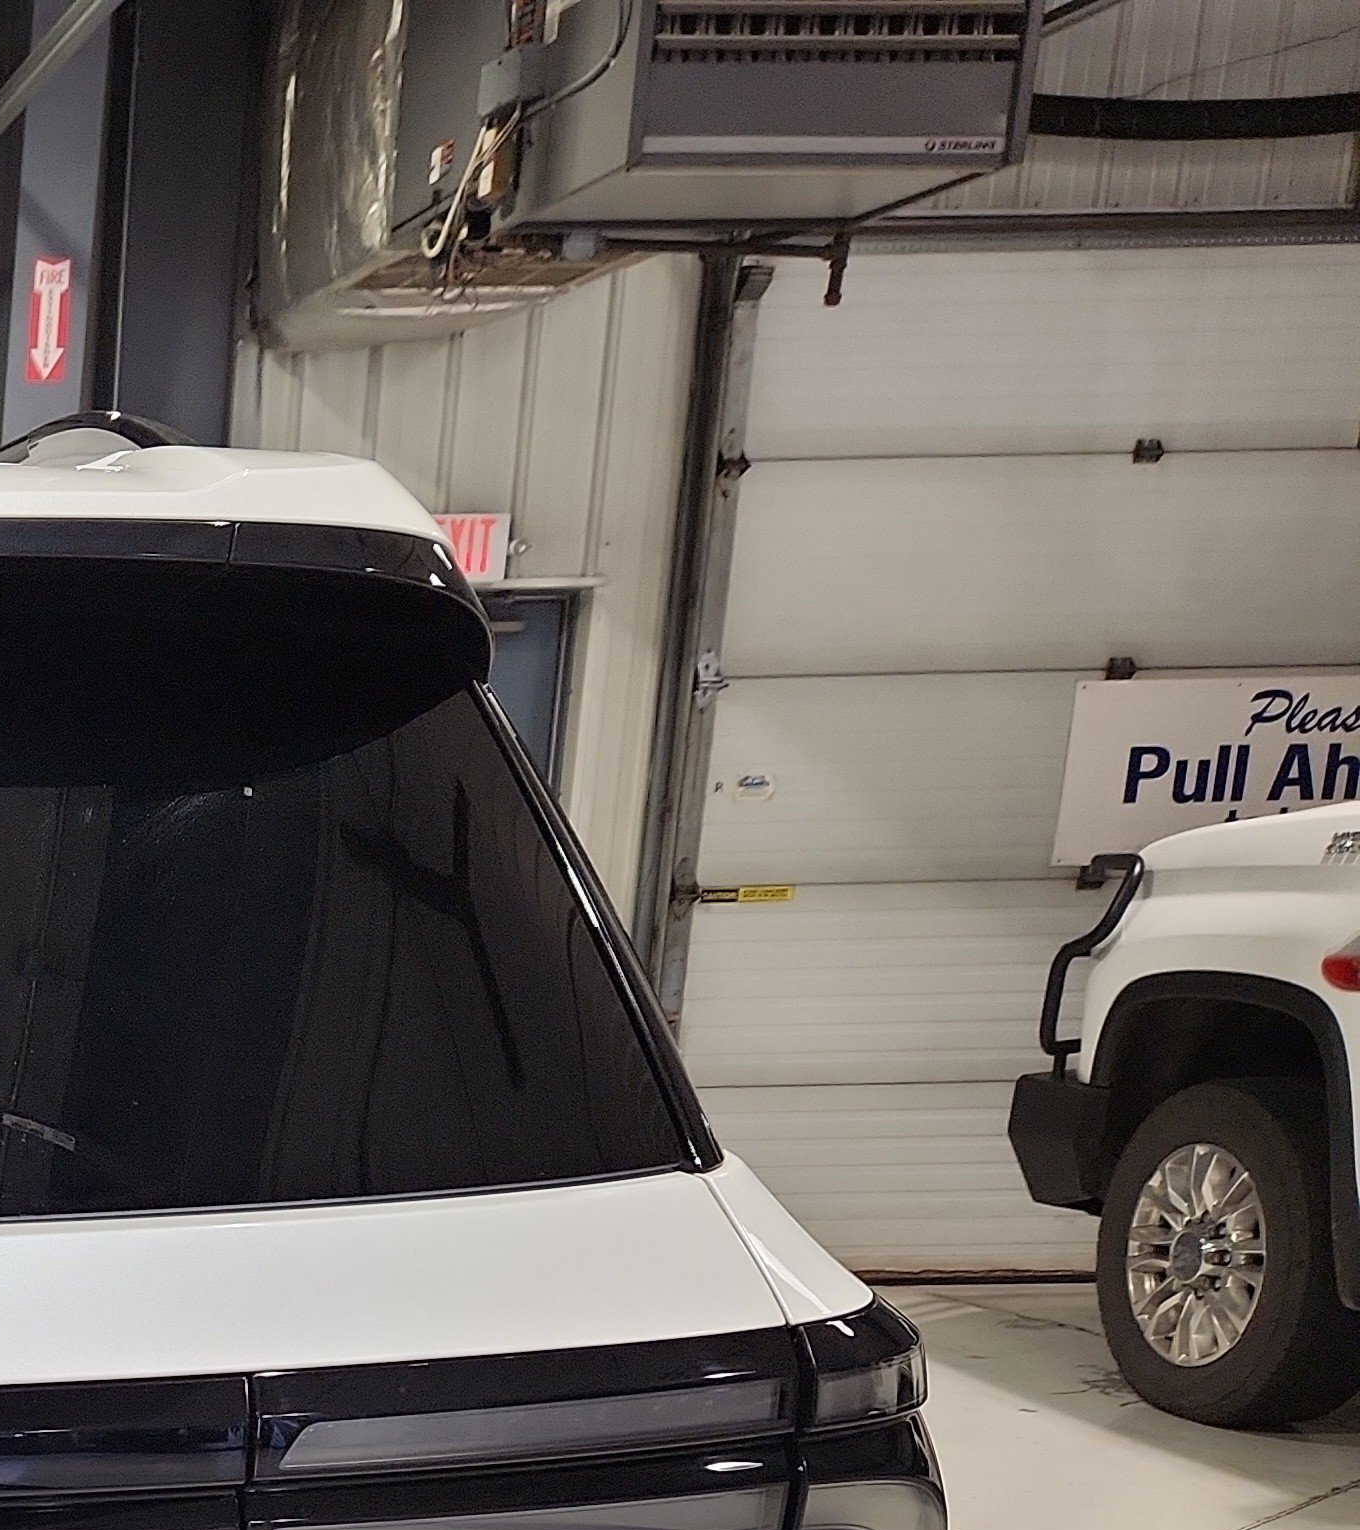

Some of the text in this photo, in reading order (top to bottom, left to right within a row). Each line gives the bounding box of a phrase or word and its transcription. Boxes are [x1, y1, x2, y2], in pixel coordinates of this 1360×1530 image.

[40, 269, 68, 284] FIRE
[434, 517, 498, 573] XIT
[1245, 689, 1360, 736] Pleas
[1123, 742, 1360, 804] Pull Ah
